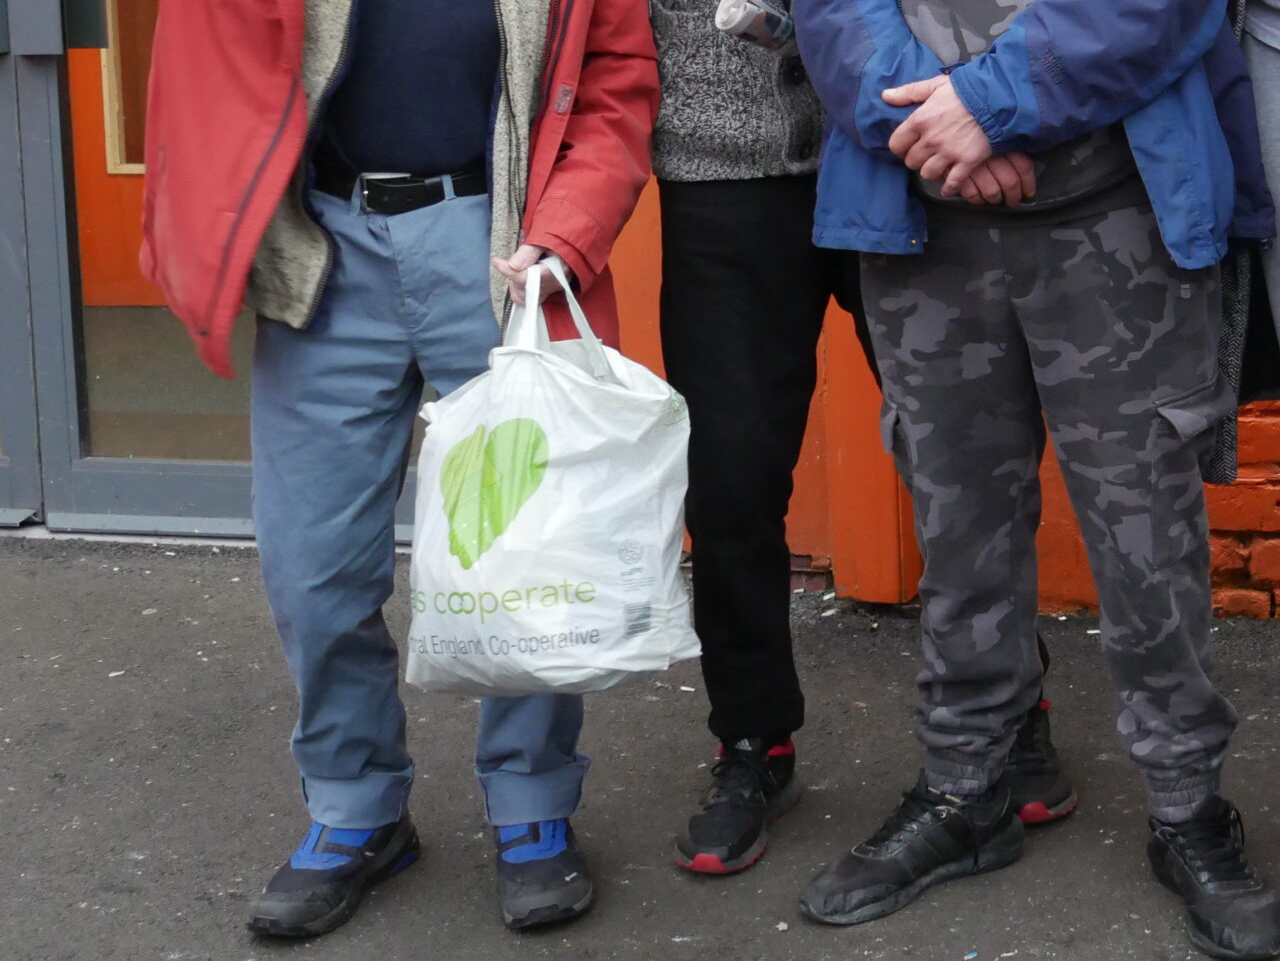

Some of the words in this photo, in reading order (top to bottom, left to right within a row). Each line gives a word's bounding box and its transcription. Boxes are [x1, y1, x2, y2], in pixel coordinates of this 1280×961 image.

[433, 579, 597, 624] cooperate
[430, 635, 484, 659] England
[488, 626, 600, 655] Co-operative
